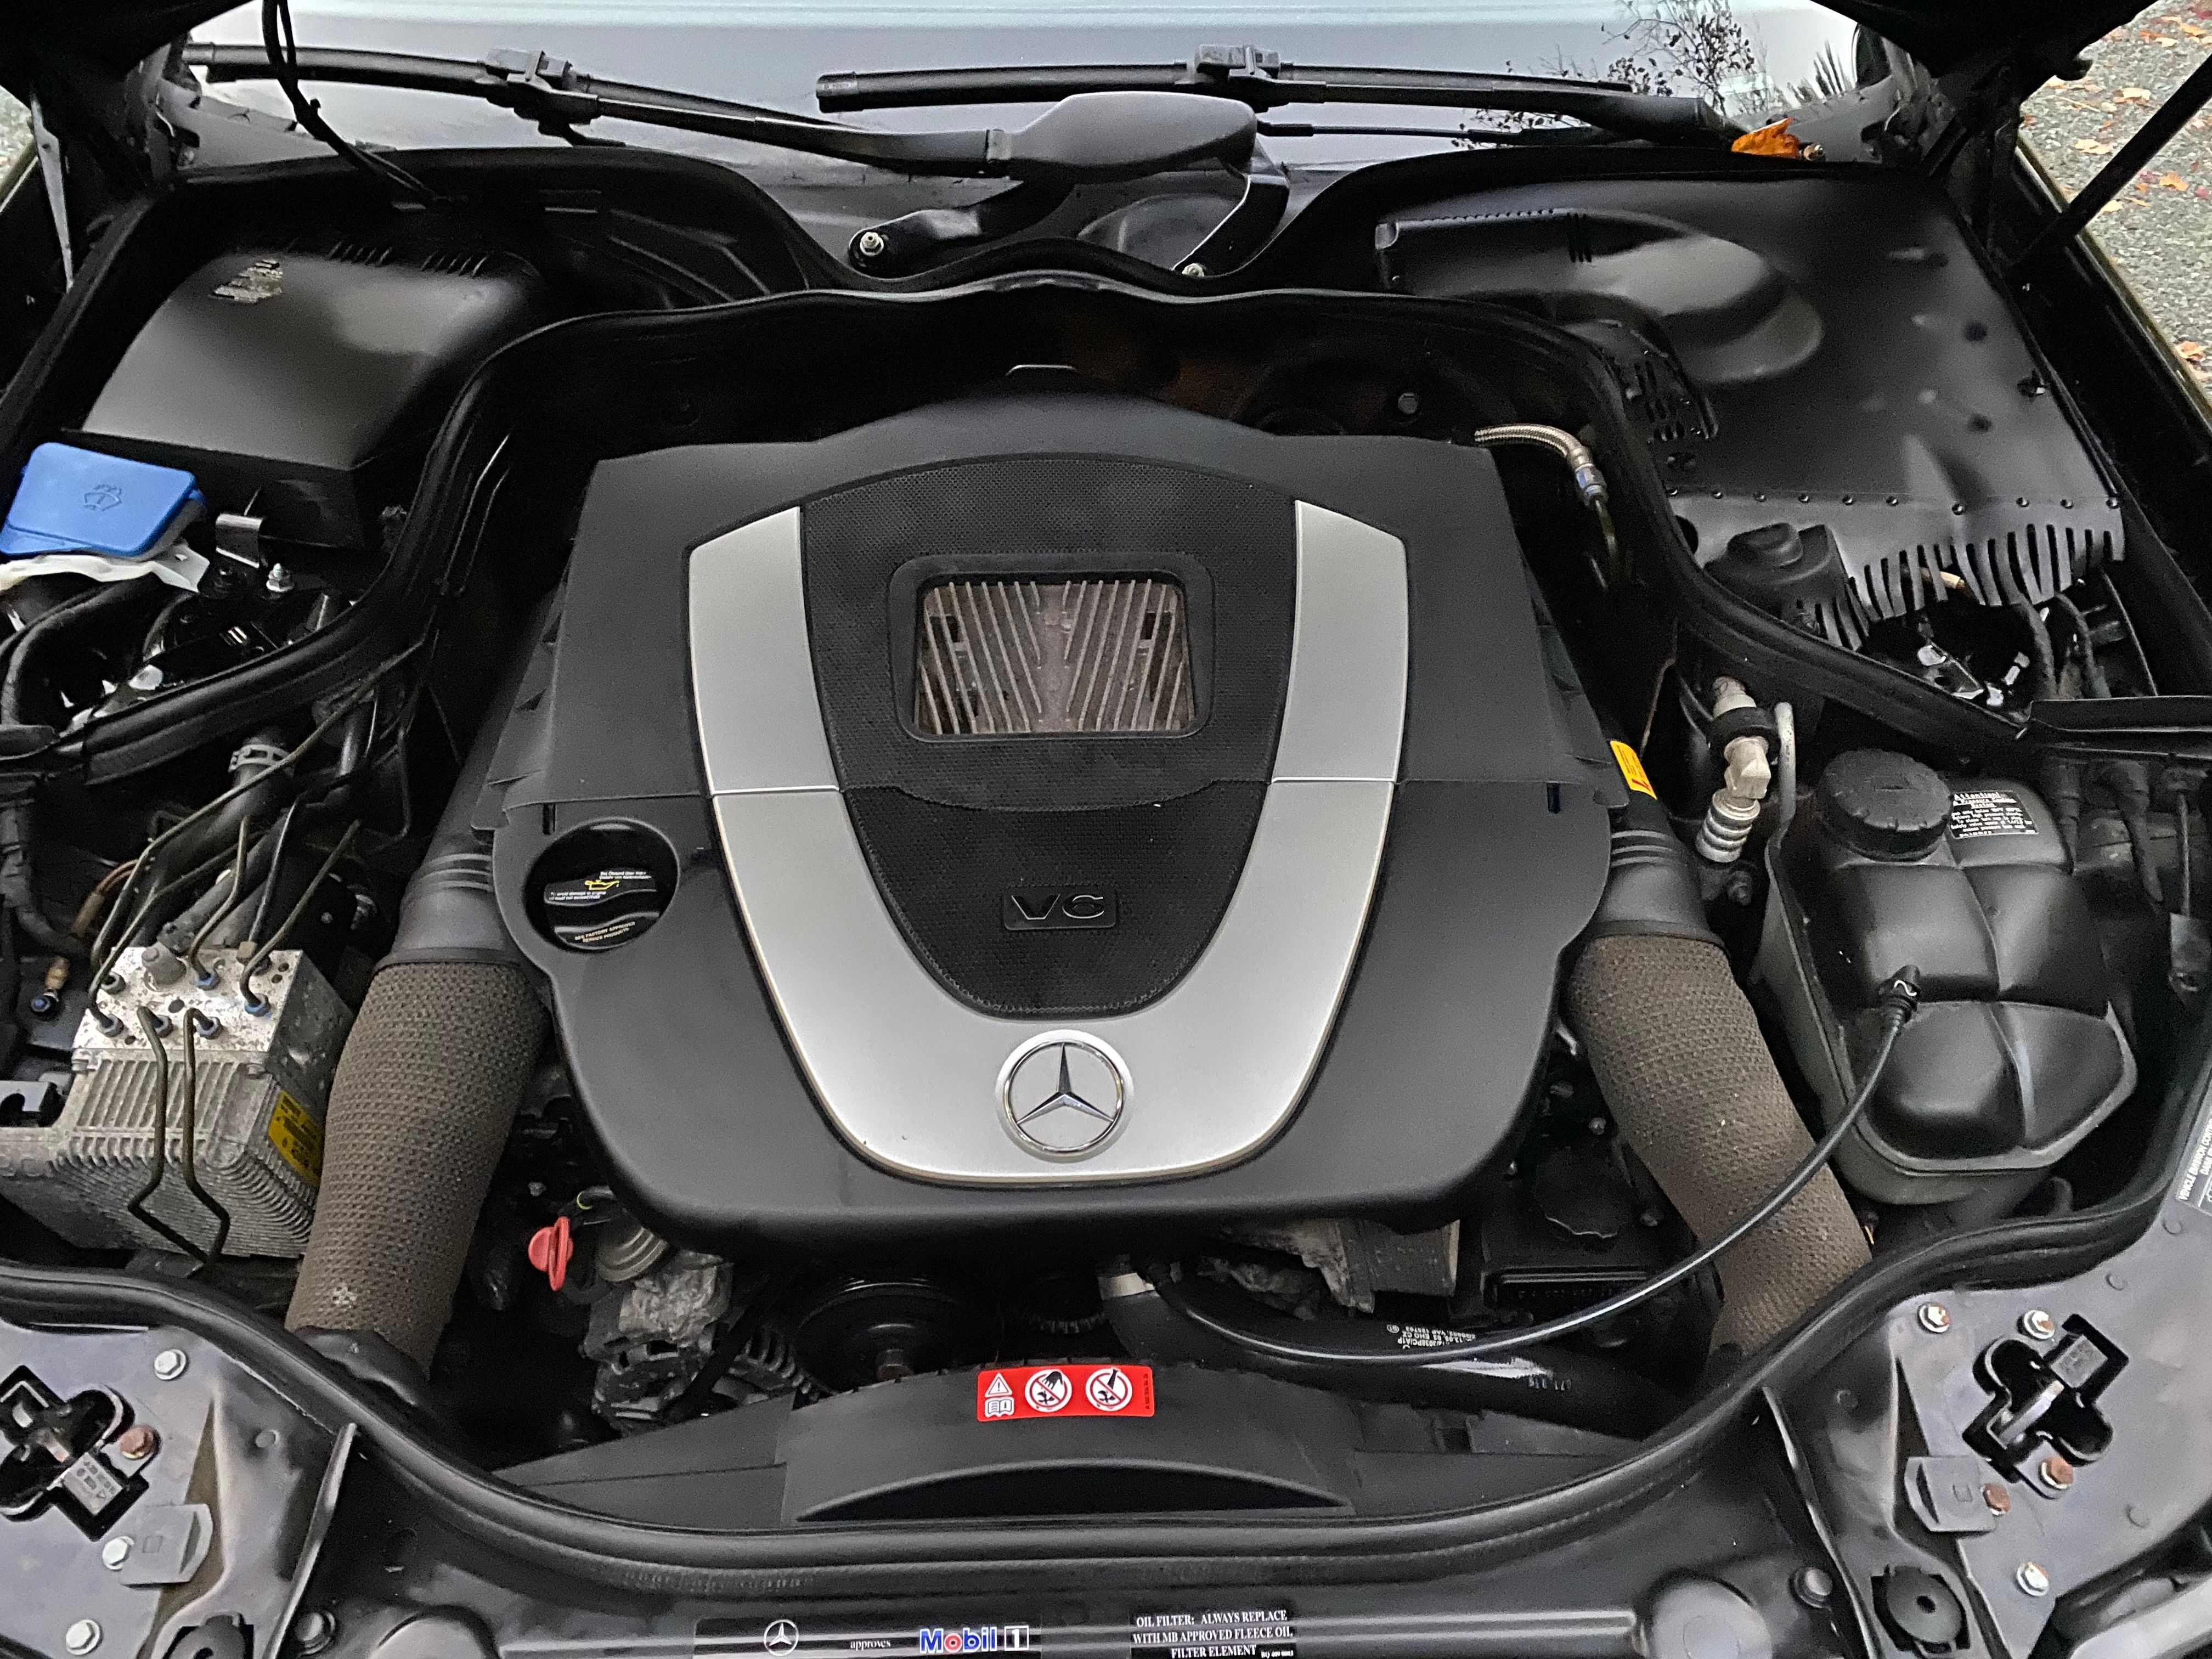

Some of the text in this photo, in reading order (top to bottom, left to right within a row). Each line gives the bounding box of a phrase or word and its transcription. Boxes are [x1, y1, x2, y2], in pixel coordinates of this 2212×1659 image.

[1011, 893, 1105, 920] V6
[2179, 1173, 2197, 1200] VEHICLE
[1136, 1610, 1287, 1628] OIL FILTER: ALWAYS REPLACE
[850, 1638, 891, 1651] approves
[919, 1627, 998, 1654] Mobil
[1133, 1626, 1293, 1644] WITH MB APPROVED FLEECE OIL
[1171, 1644, 1257, 1659] FILTER ELEMENT
